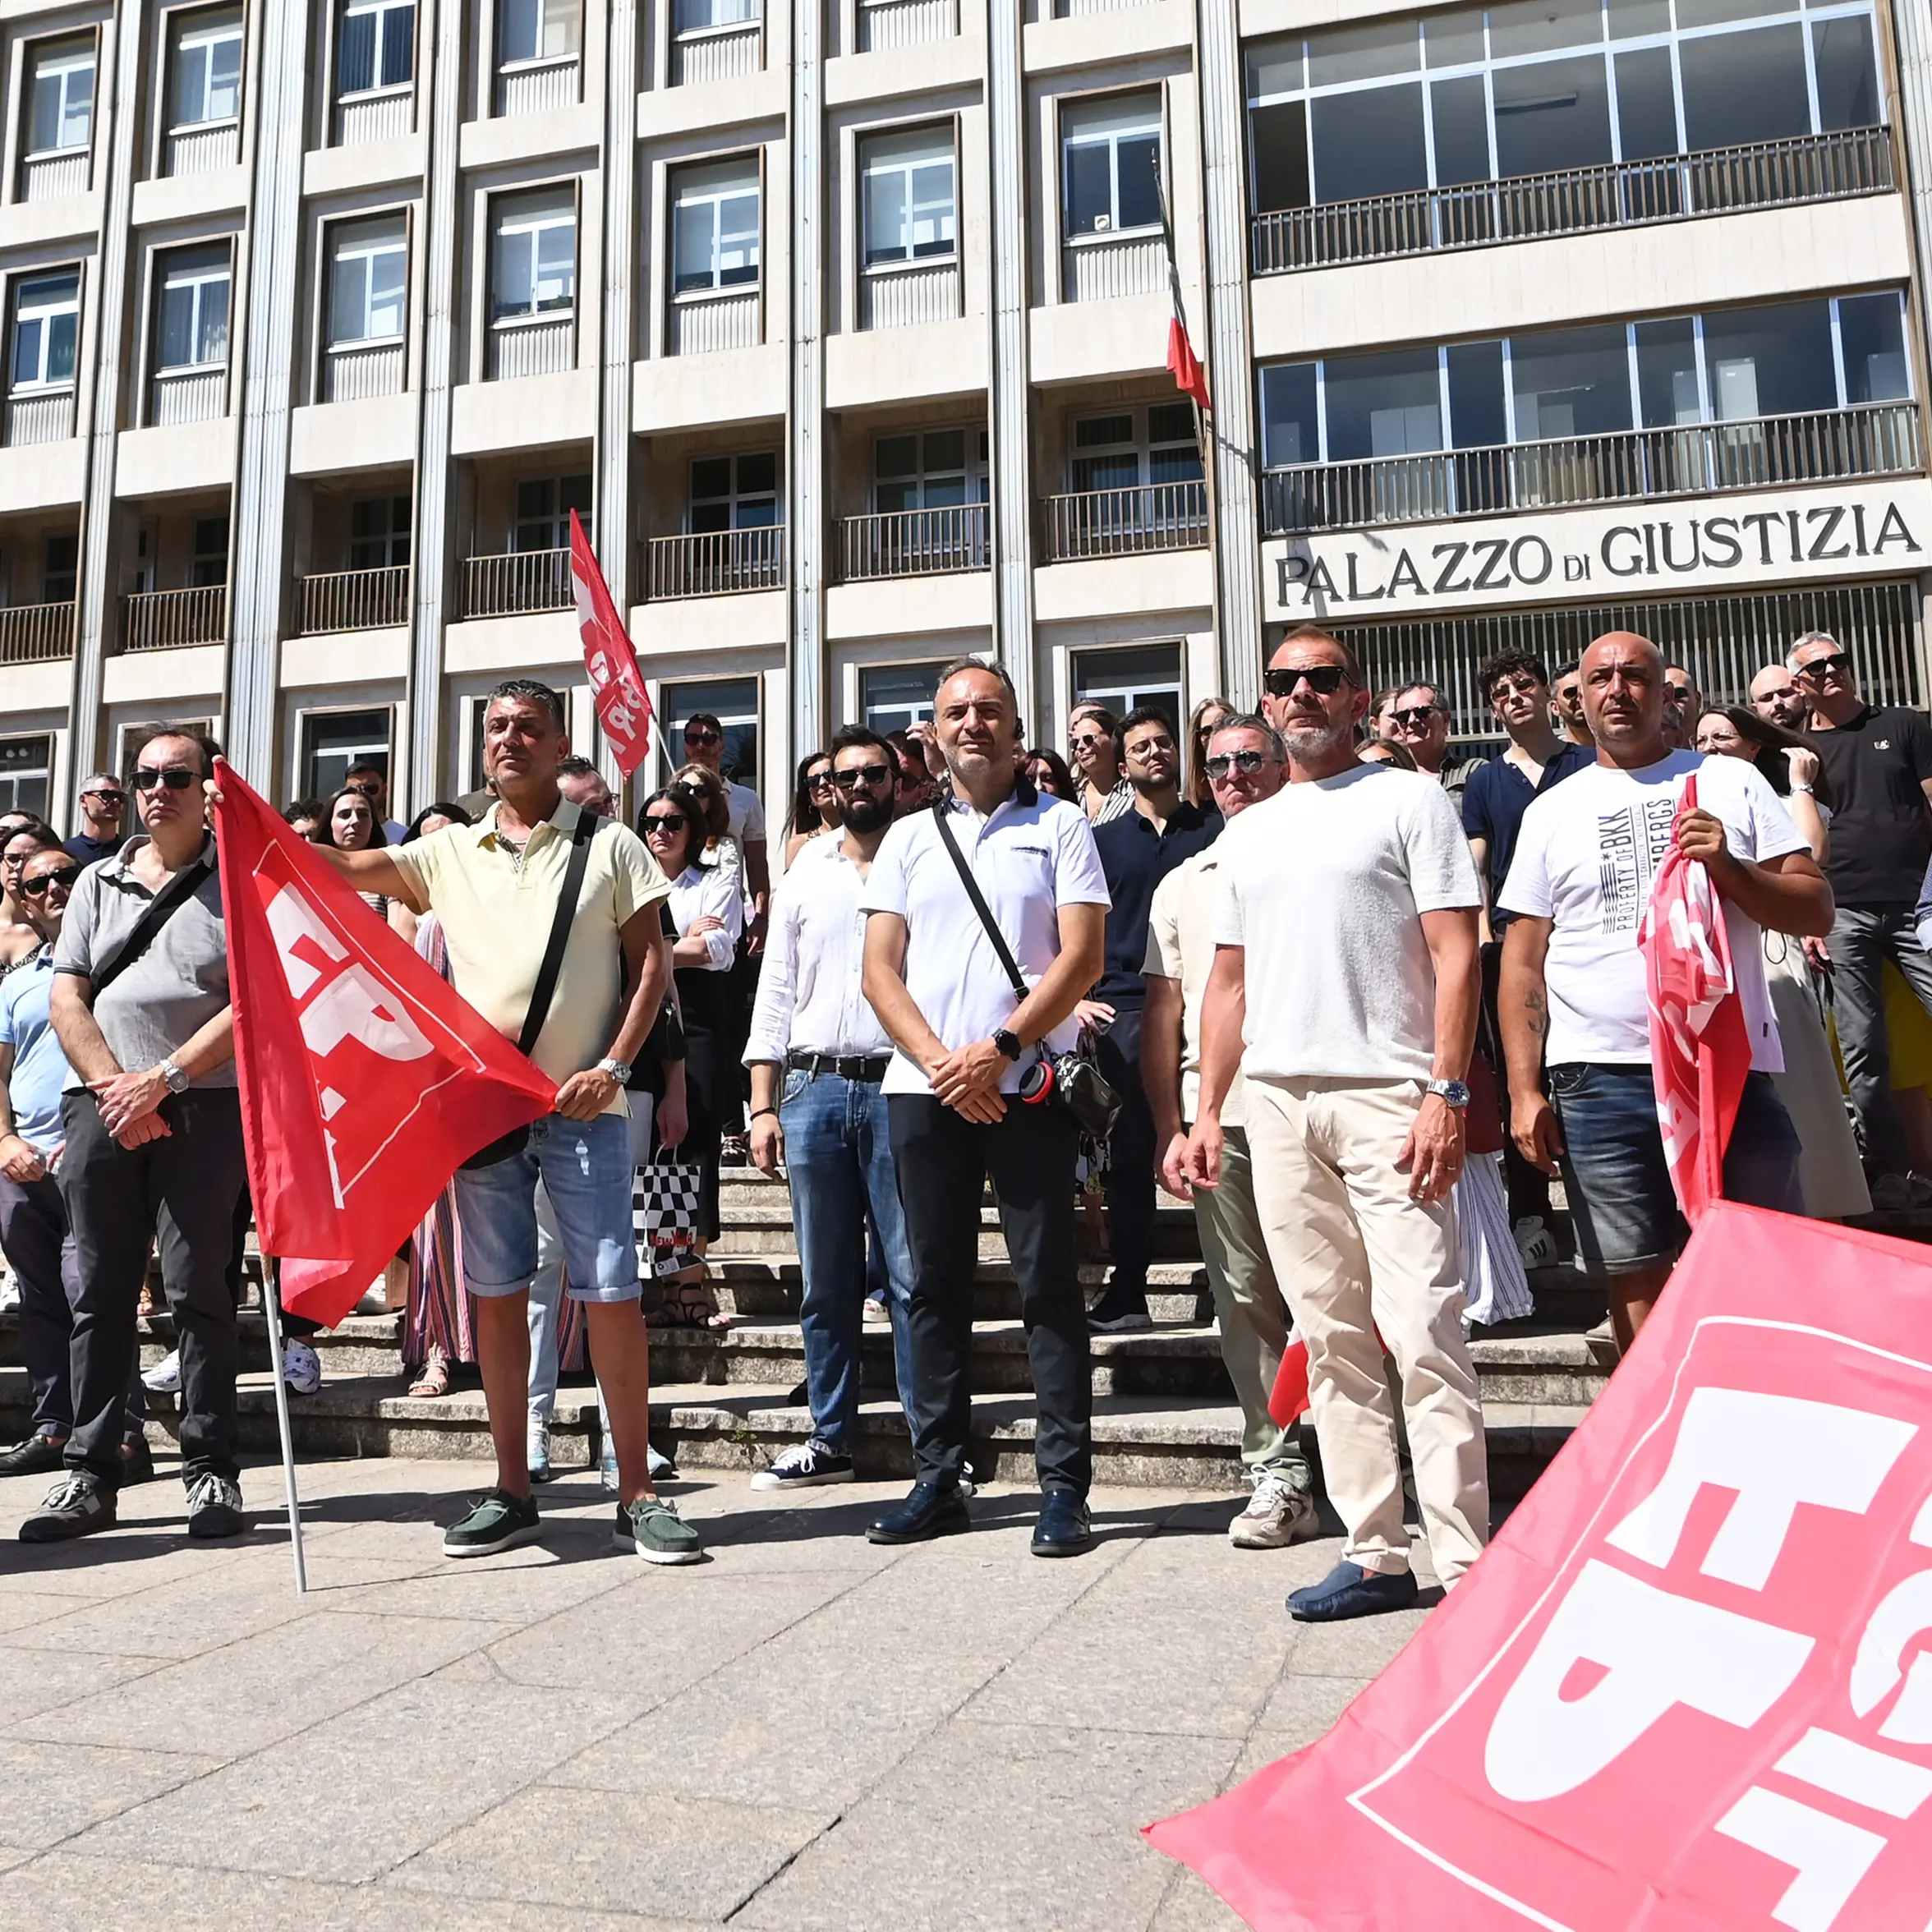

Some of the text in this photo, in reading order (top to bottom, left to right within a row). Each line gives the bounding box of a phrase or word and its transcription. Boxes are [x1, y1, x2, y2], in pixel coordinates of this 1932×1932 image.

[1276, 535, 1552, 607] PALAZZO
[1600, 501, 1922, 577] GIUSTIZIA
[1598, 807, 1632, 849] BKK
[1615, 848, 1634, 862] OF
